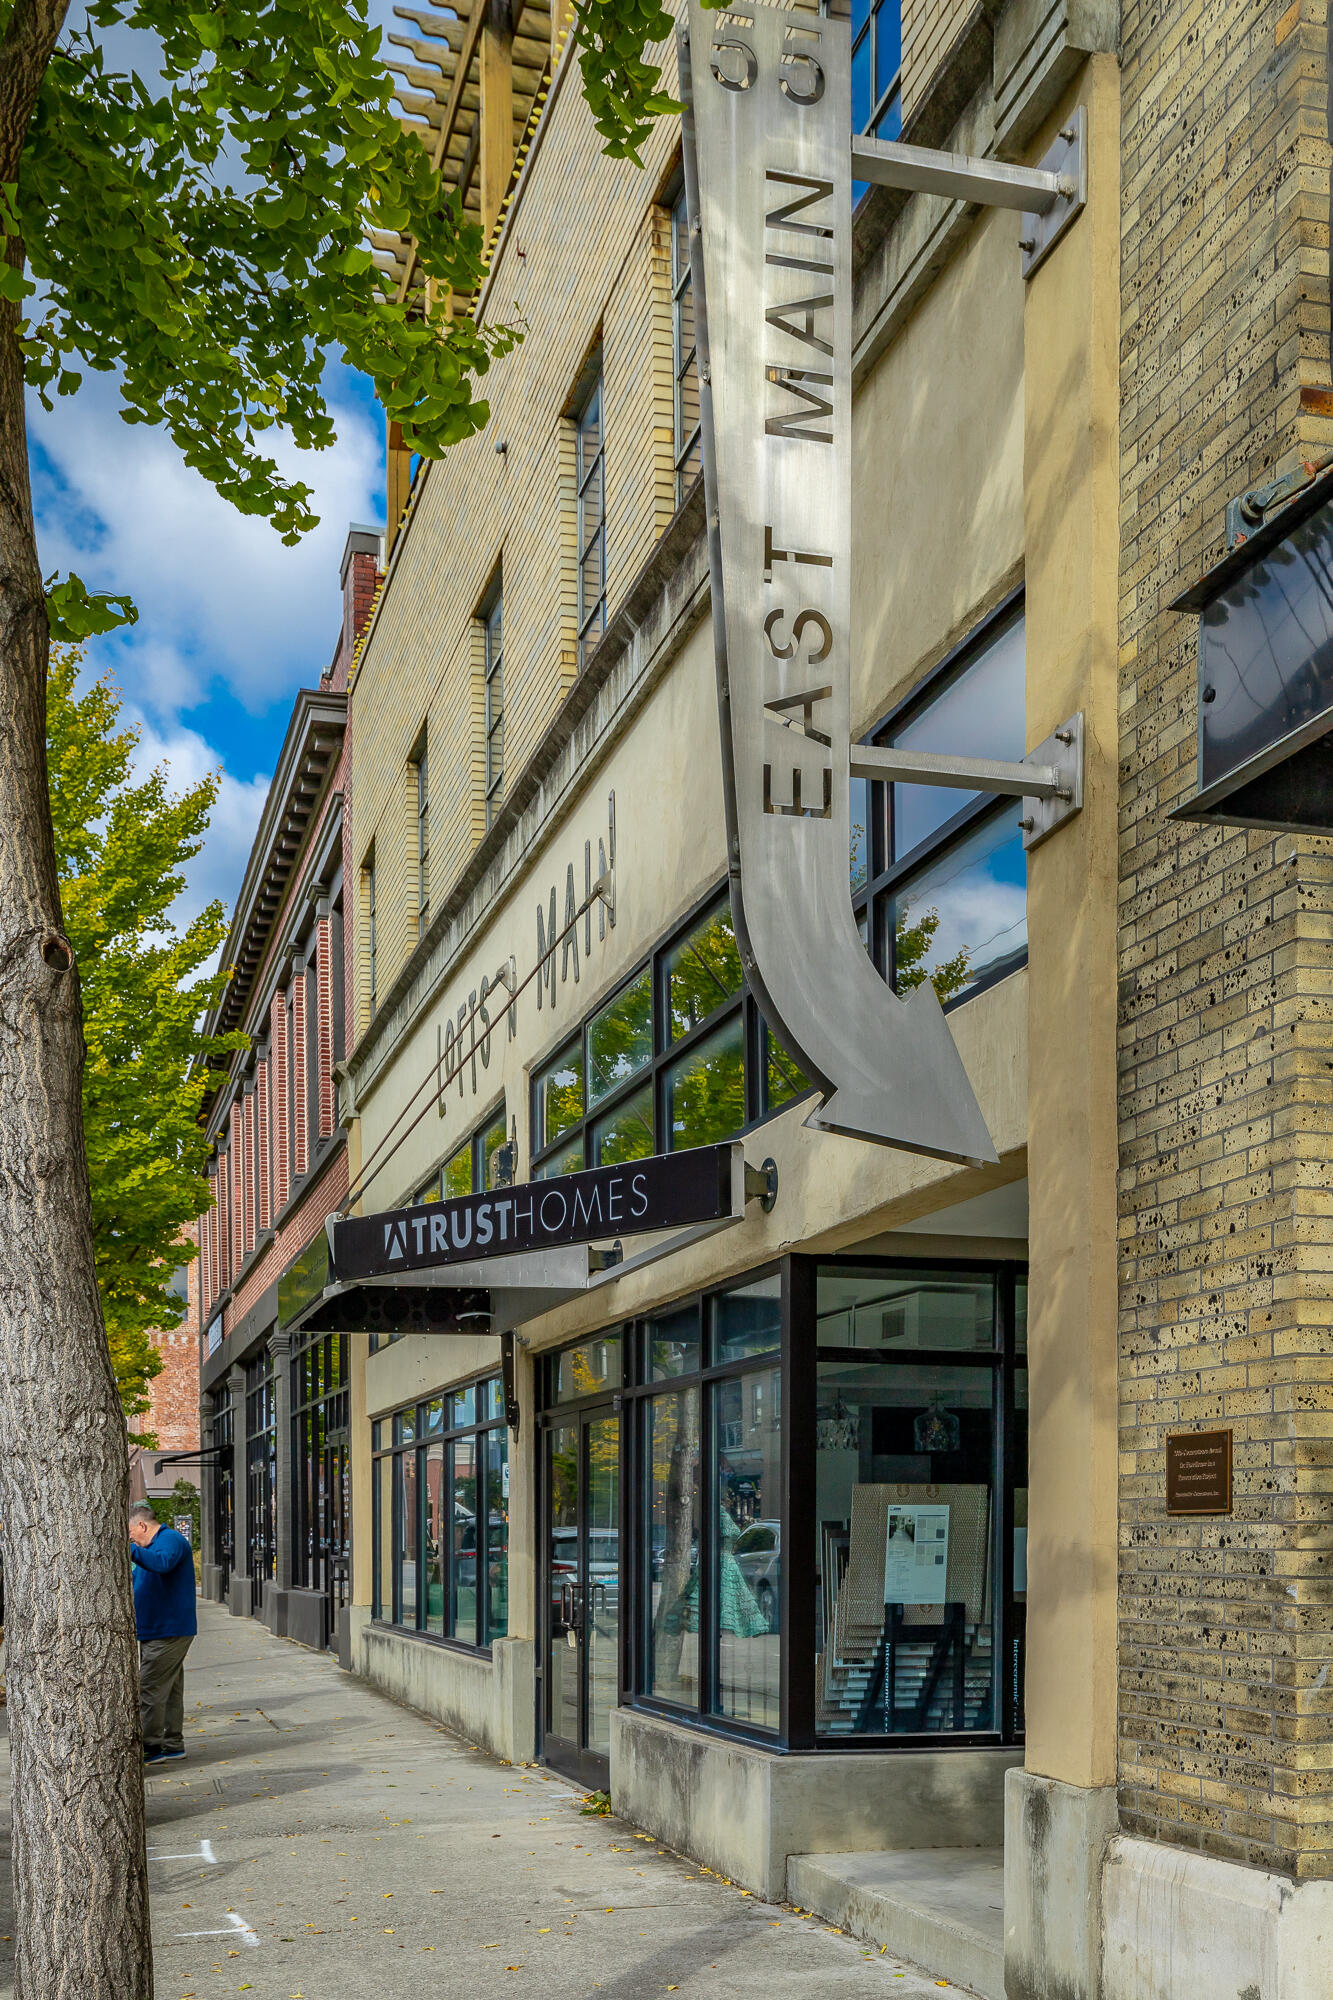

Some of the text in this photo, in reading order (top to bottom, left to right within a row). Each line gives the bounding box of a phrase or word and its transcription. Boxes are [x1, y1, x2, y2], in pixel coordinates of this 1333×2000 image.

[710, 11, 826, 106] 55
[763, 169, 835, 820] EAST MAIN
[437, 974, 491, 1119] LOFTS
[536, 788, 616, 1011] MAIN
